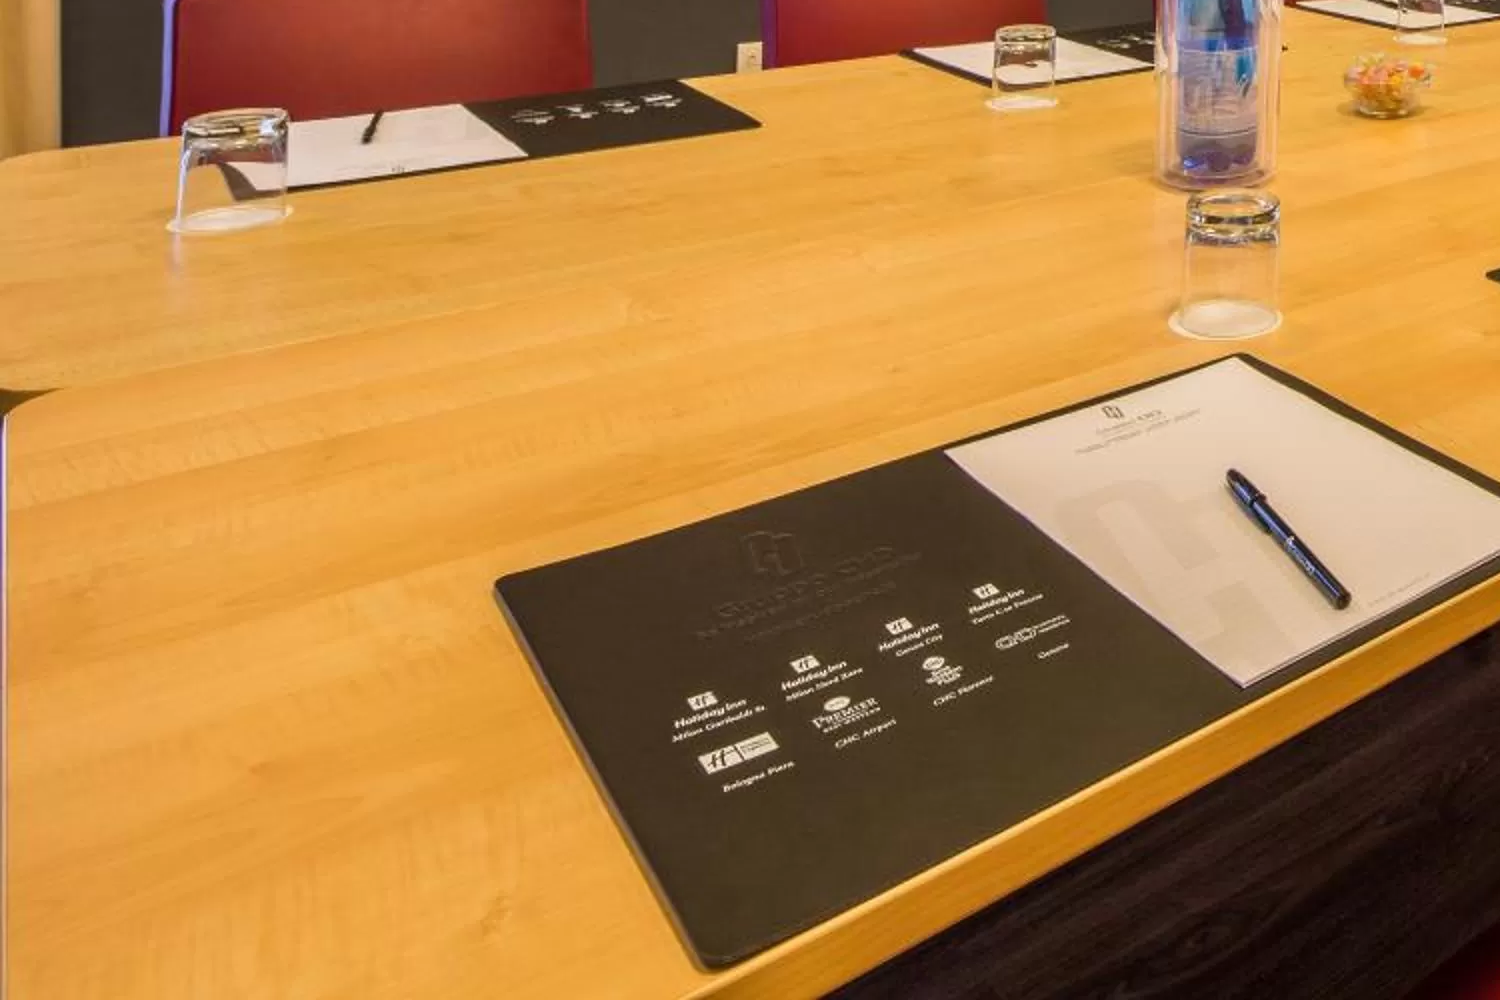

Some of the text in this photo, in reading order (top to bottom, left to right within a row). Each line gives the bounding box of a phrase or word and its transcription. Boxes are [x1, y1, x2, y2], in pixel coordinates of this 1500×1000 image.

[921, 622, 941, 634] Inn
[781, 660, 848, 692] Holiday Inn
[674, 698, 748, 729] Holiday Inn
